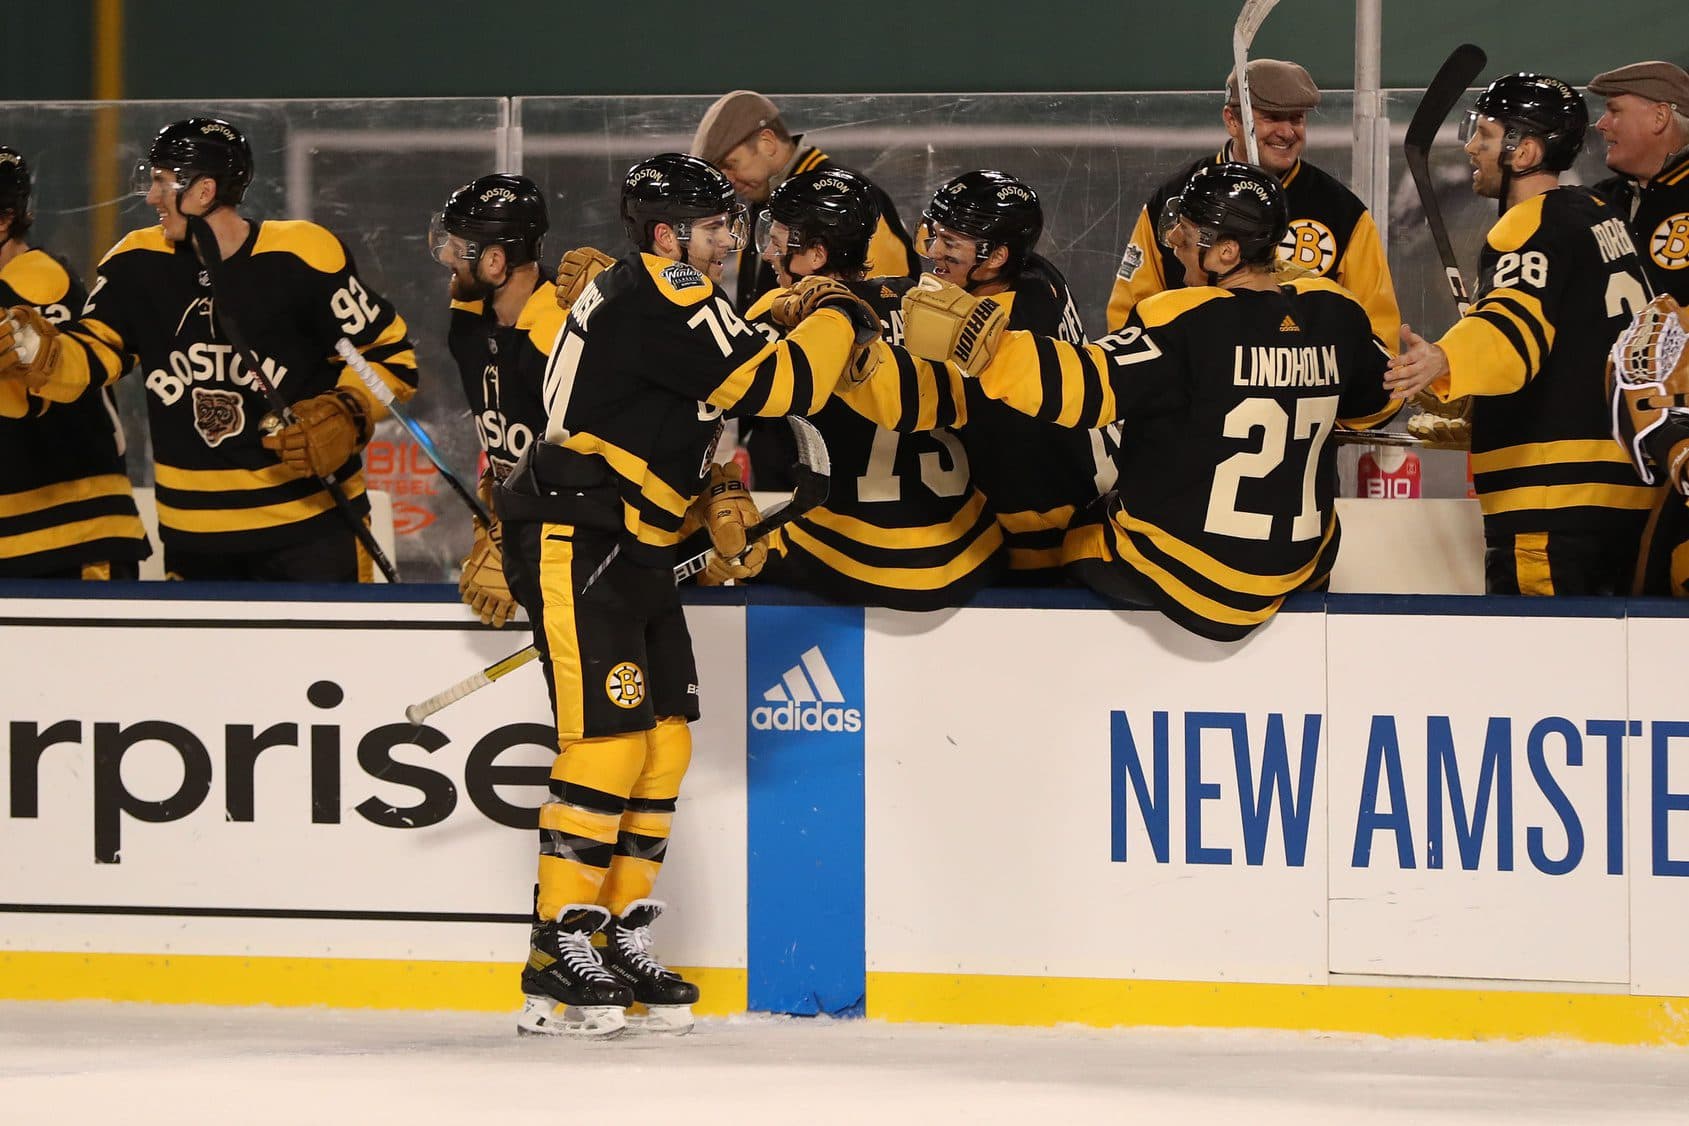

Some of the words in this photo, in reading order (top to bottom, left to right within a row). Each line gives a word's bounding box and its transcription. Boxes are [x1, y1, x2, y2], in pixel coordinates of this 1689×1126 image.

[200, 124, 237, 141] BOSTON
[480, 187, 518, 203] BOSTON
[629, 167, 663, 188] BOSTON
[812, 179, 850, 195] BOSTON
[996, 186, 1030, 202] BOSTON
[1232, 180, 1269, 202] BOSTON
[1493, 250, 1549, 289] 28
[330, 276, 380, 335] 92
[687, 297, 753, 358] 74
[1094, 326, 1163, 366] 27
[145, 342, 288, 406] BOSTON
[1233, 345, 1340, 388] LINDHOLM
[475, 410, 534, 457] OSTO
[1204, 394, 1340, 542] 27
[1367, 478, 1410, 498] BIO
[751, 702, 863, 733] adidas
[1110, 709, 1322, 868] NEW
[1350, 714, 1689, 878] AMSTE
